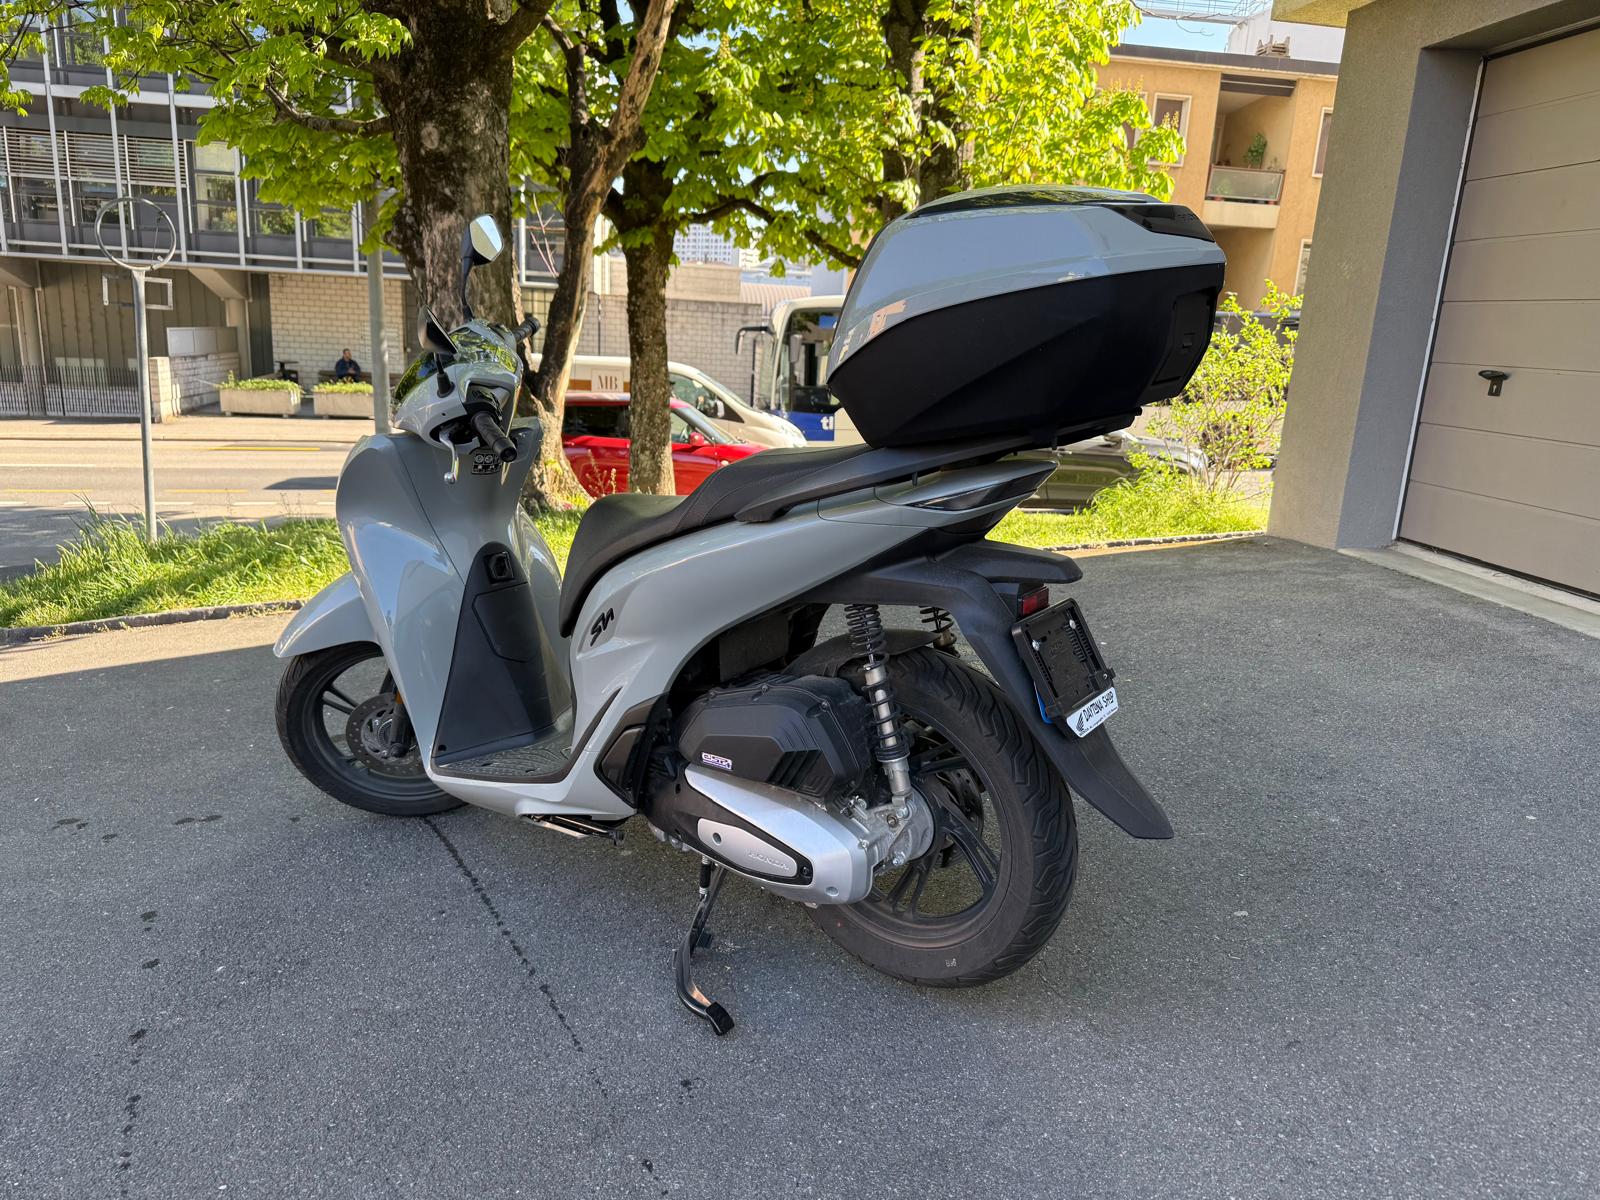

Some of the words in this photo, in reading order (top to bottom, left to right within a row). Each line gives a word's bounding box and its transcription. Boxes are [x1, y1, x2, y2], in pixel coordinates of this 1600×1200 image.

[598, 375, 618, 390] MB
[1082, 699, 1104, 722] DAYTONA
[1101, 690, 1114, 708] SHOP
